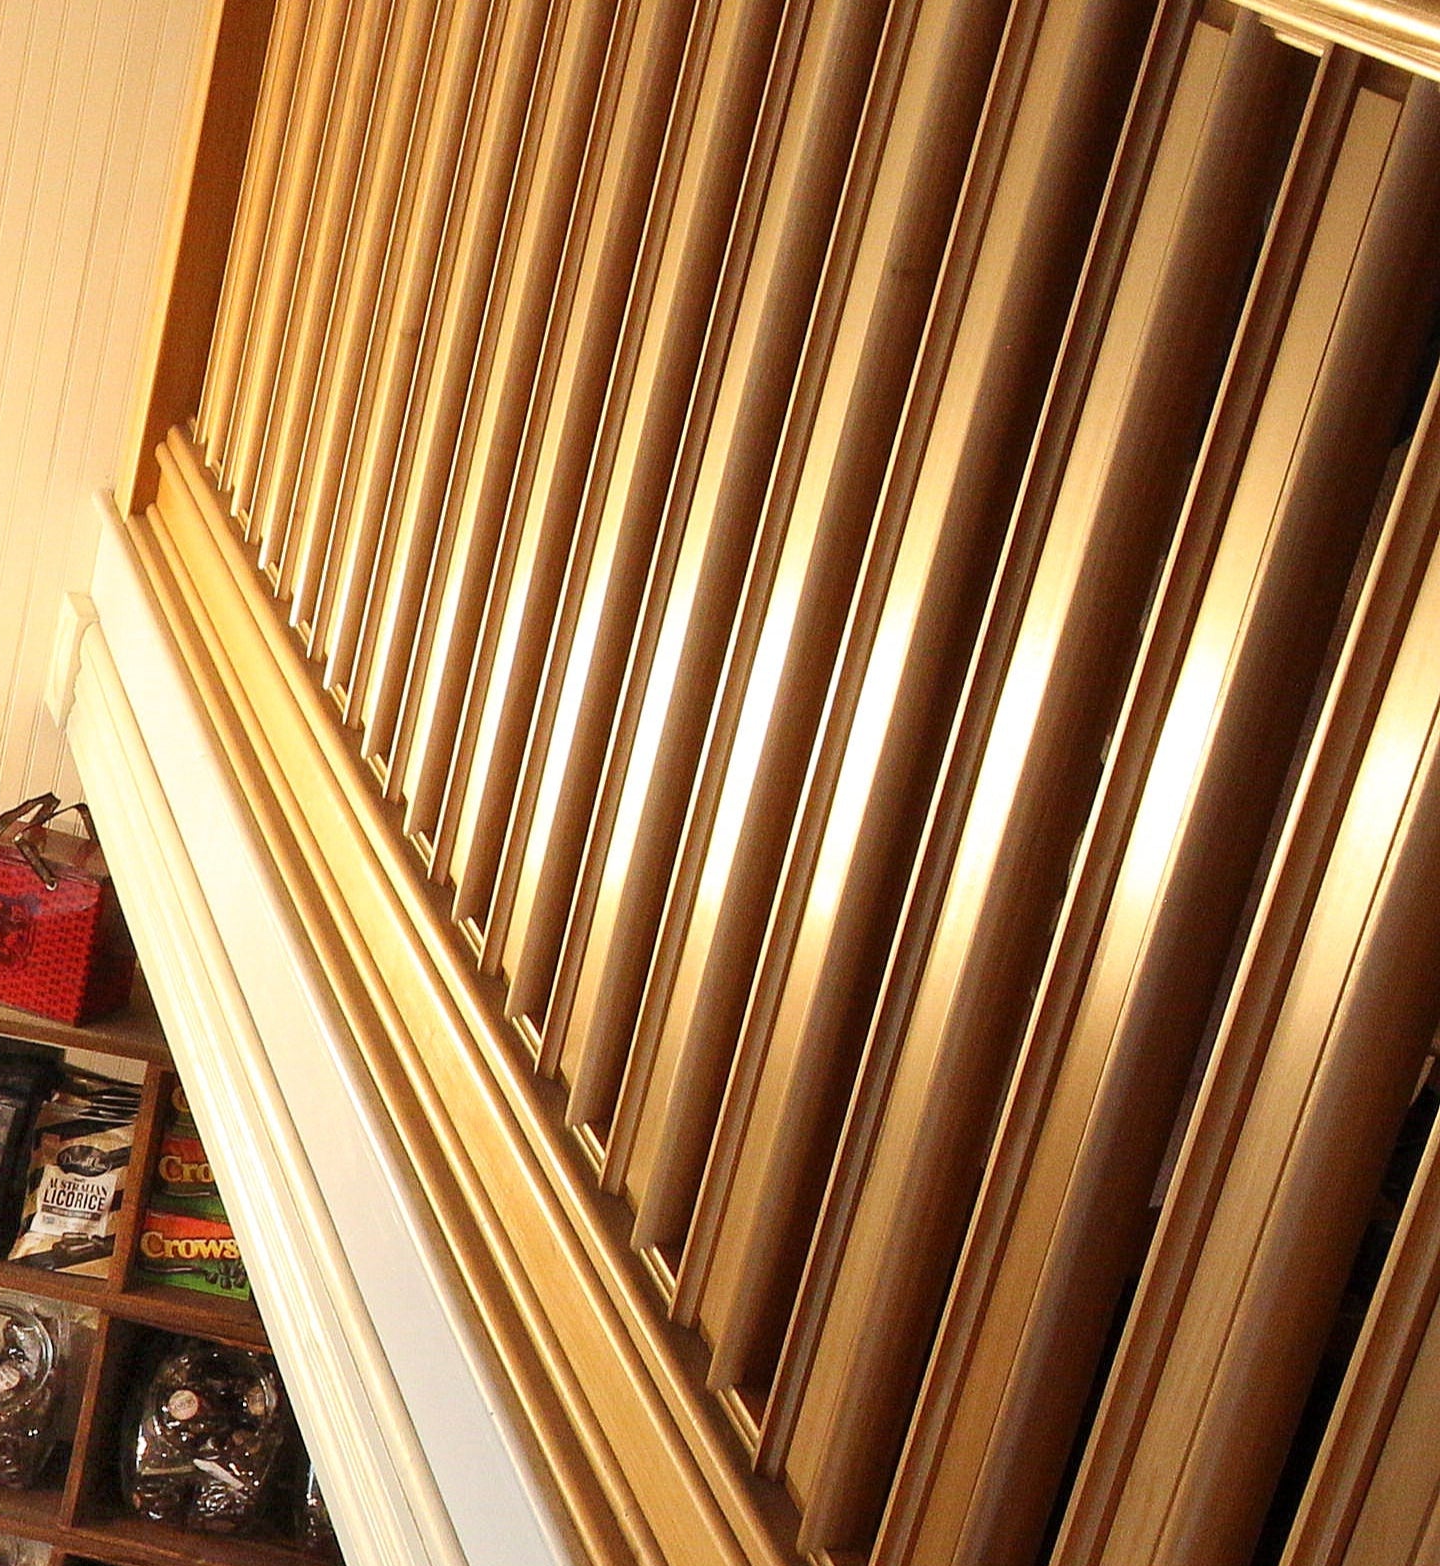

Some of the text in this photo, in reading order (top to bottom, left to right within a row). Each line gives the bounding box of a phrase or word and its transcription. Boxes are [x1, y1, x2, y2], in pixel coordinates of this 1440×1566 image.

[159, 1155, 216, 1184] Cro
[43, 1188, 107, 1213] LICORICE
[139, 1231, 240, 1260] Crows
